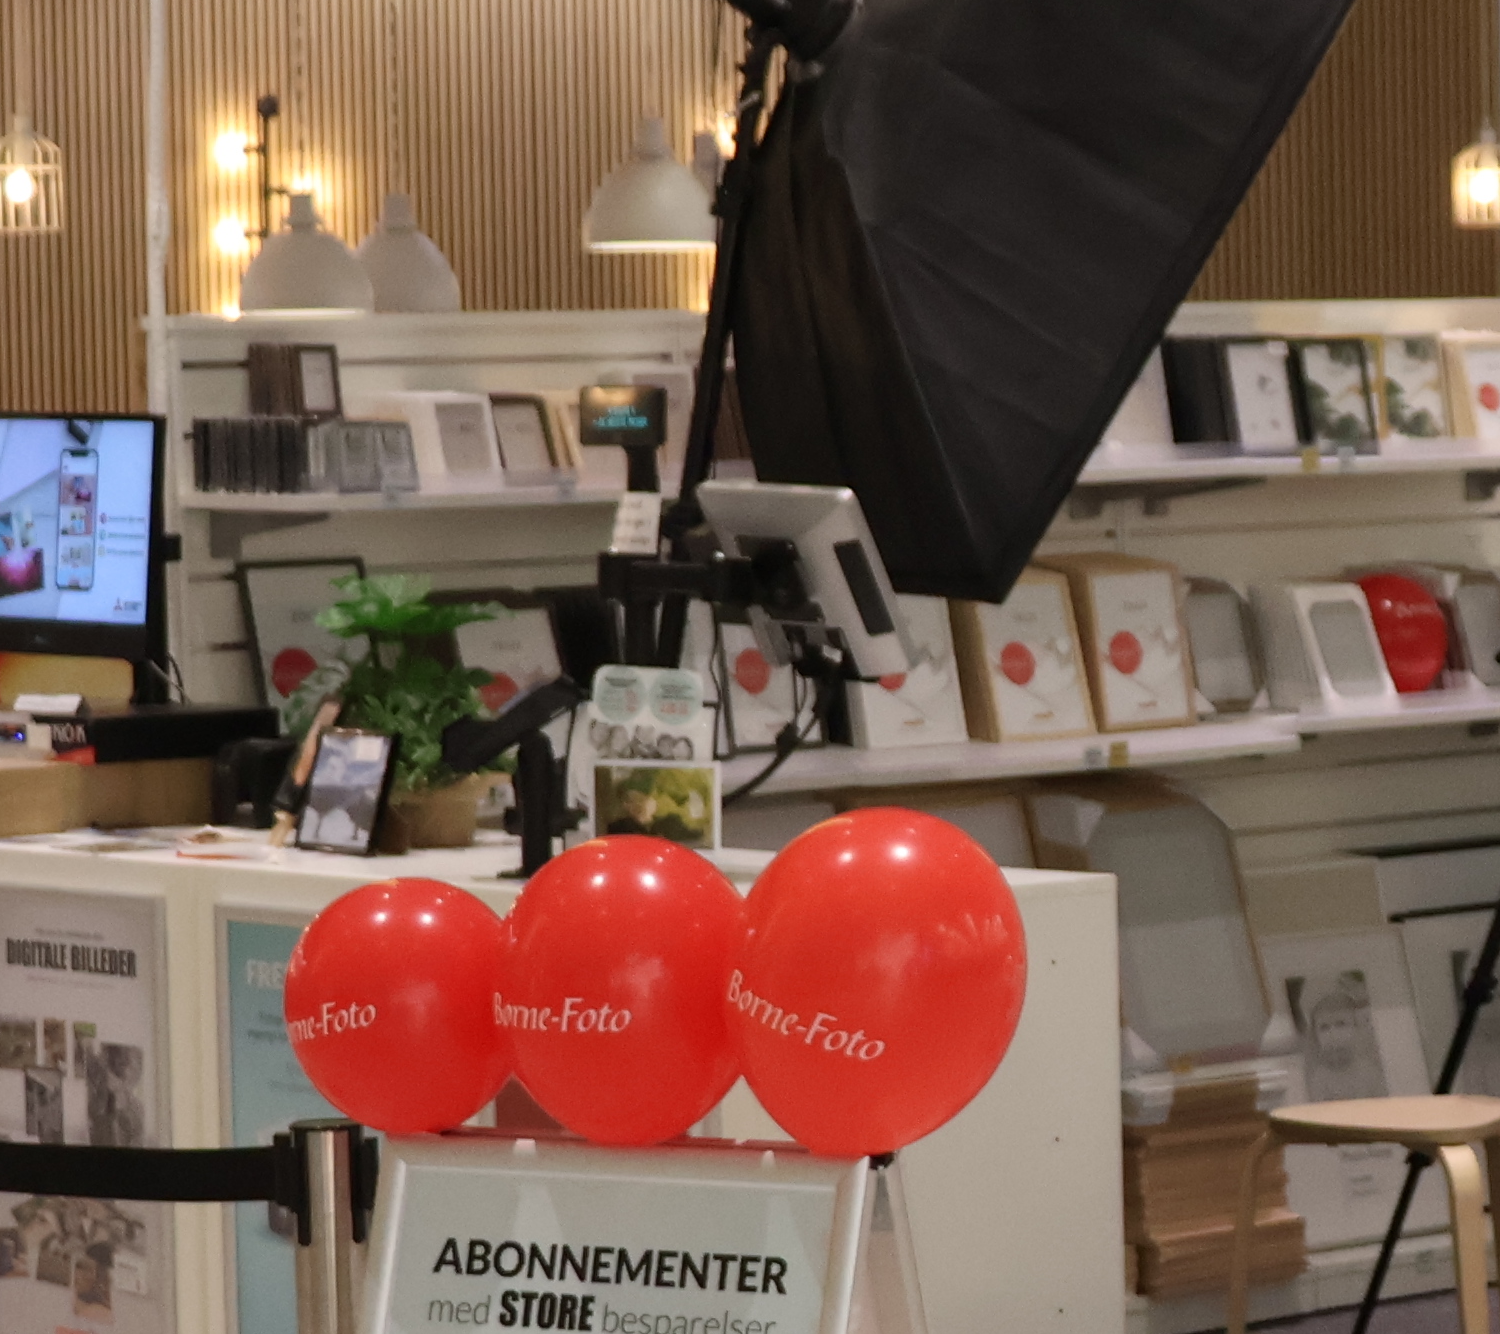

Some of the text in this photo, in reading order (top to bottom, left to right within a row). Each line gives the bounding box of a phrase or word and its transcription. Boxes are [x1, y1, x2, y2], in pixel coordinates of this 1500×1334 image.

[431, 1236, 789, 1296] ABONNEMENTER
[426, 1295, 493, 1326] med
[498, 1289, 597, 1333] STORE
